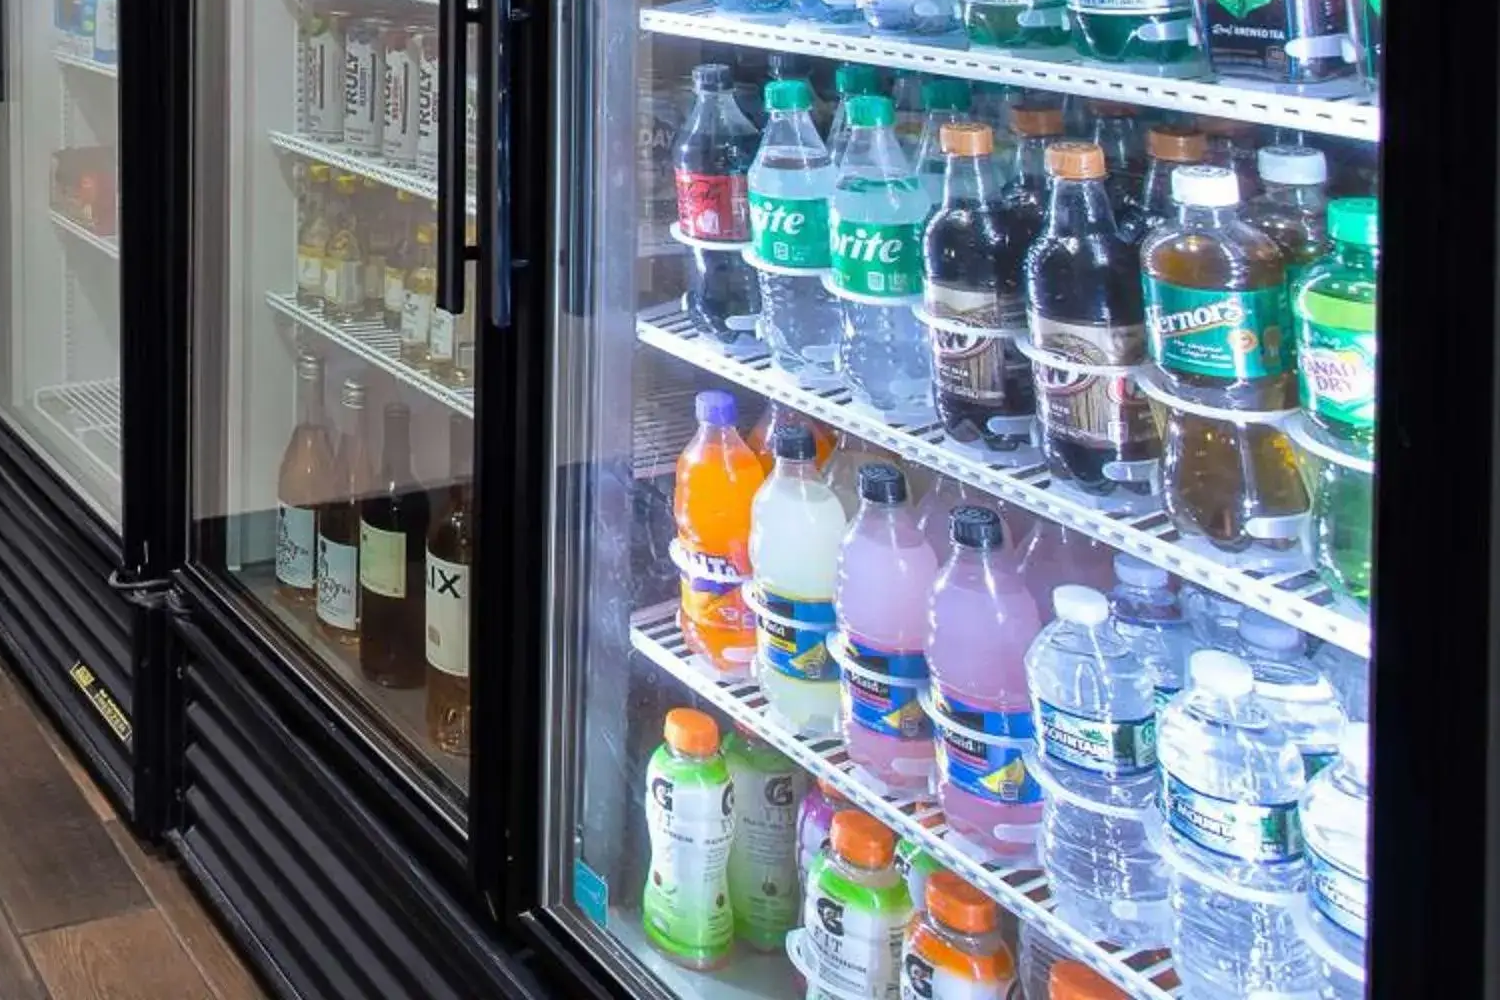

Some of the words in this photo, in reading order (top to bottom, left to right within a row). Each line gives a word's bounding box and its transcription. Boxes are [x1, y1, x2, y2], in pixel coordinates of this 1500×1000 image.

[345, 53, 360, 117] TRULY
[418, 68, 433, 138] TRULY
[428, 564, 460, 599] IX
